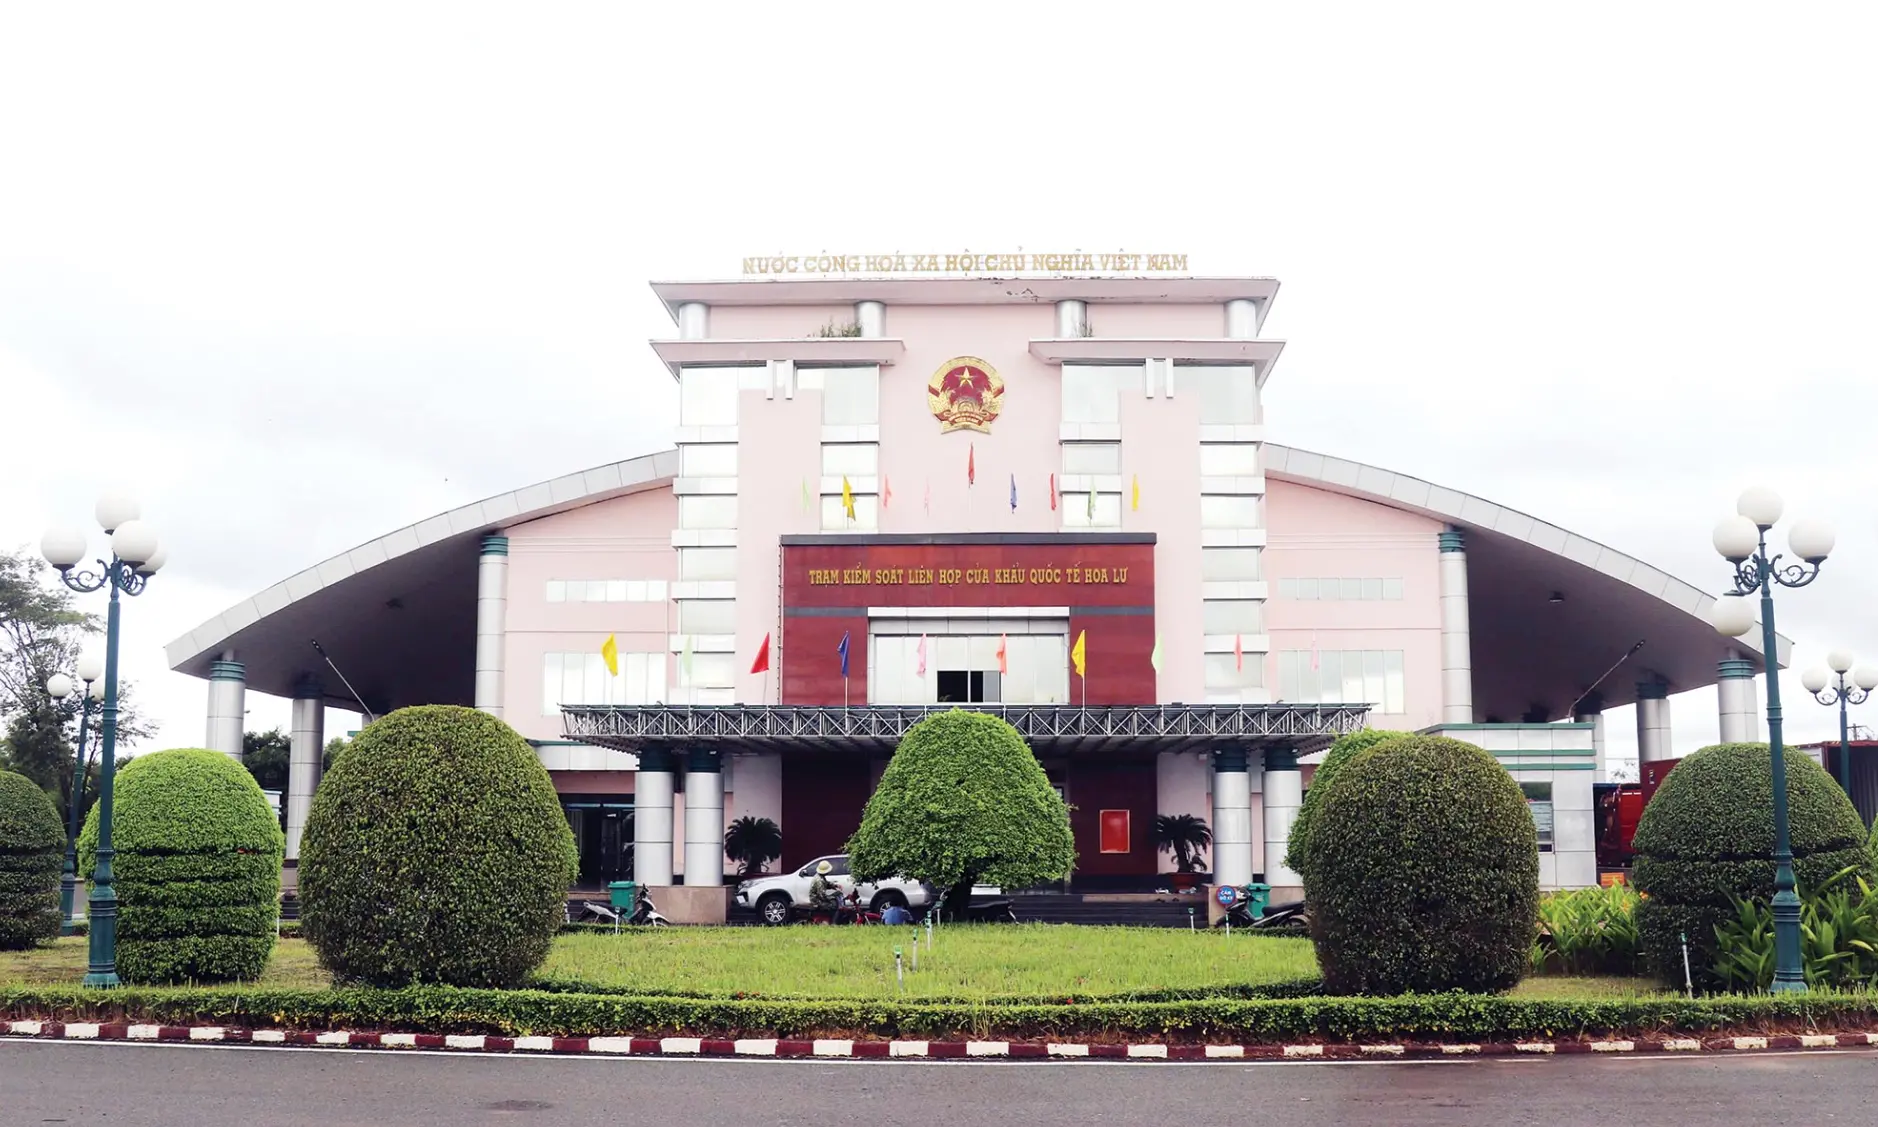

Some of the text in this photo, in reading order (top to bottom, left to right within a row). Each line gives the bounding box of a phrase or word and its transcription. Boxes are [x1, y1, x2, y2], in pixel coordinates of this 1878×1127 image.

[946, 248, 980, 276] HỘI
[1032, 247, 1095, 271] NGHĨA
[1146, 253, 1188, 271] NAM
[875, 564, 904, 584] SOÁT
[1029, 561, 1061, 584] QUỐC
[1066, 561, 1081, 584] TẾ
[1084, 568, 1108, 584] HOA
[1112, 567, 1128, 584] LƯ
